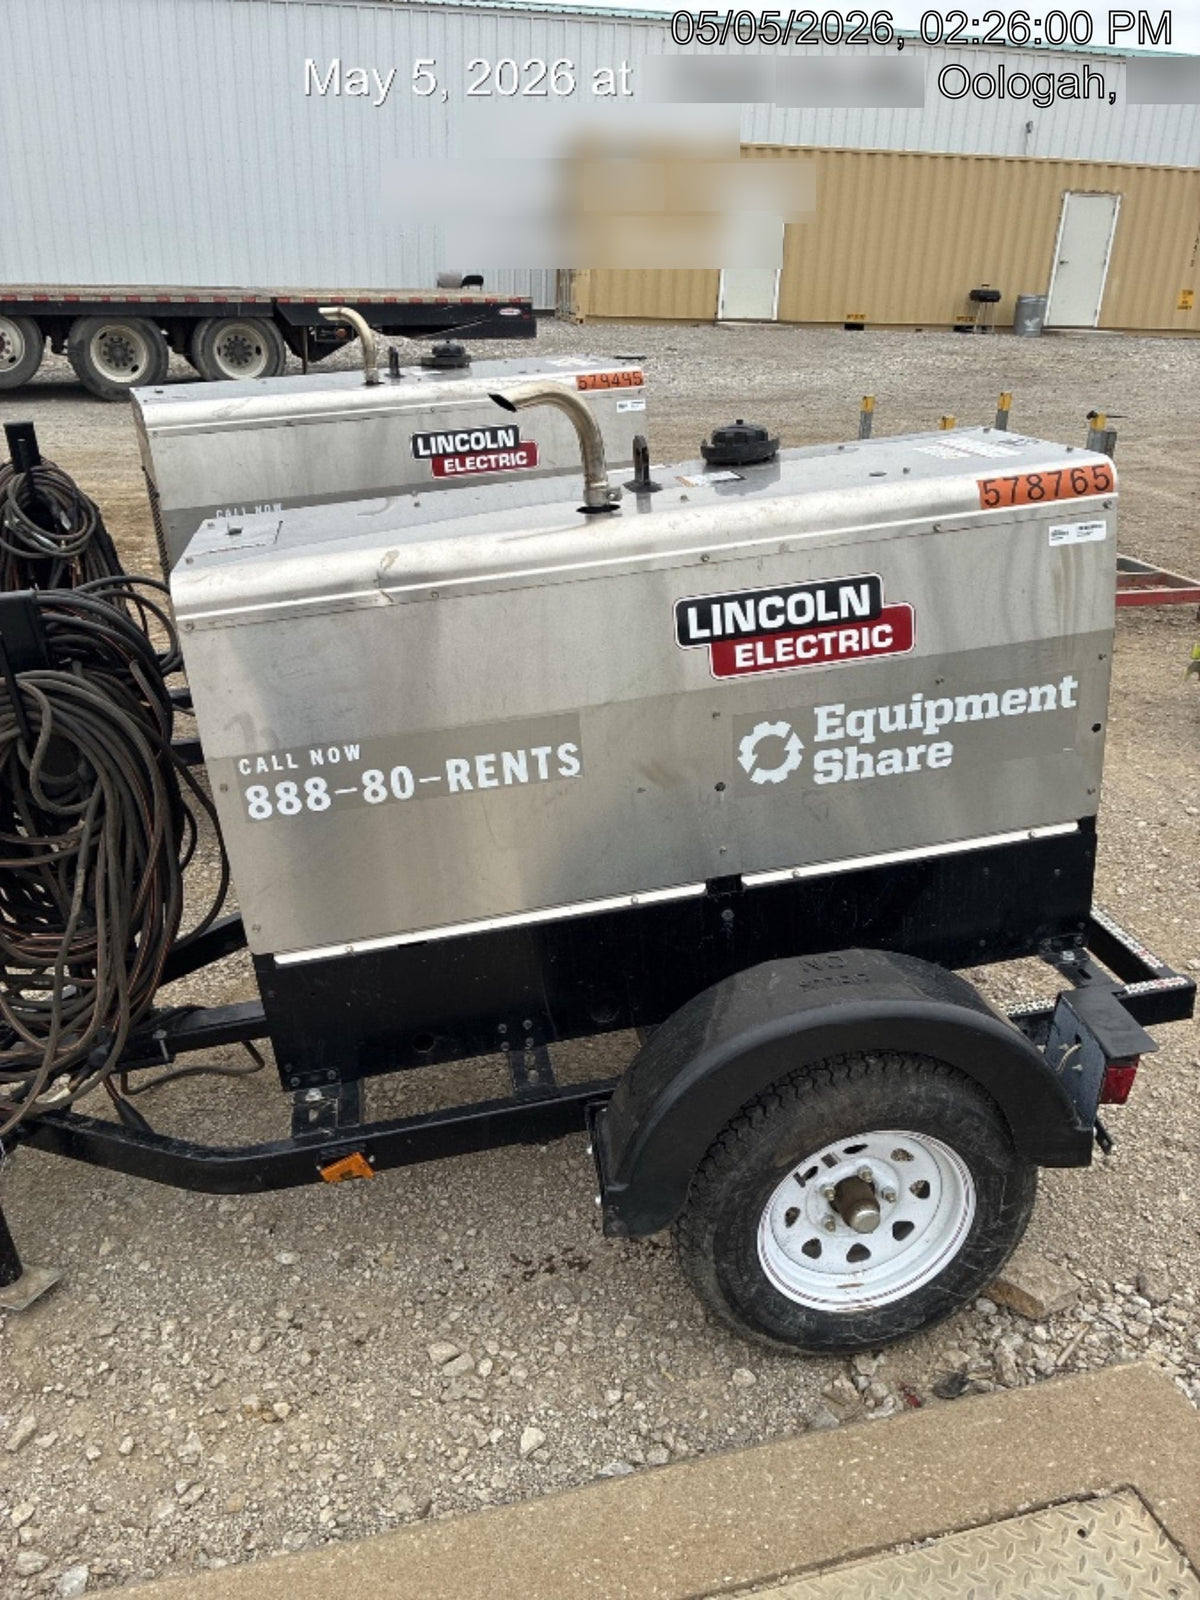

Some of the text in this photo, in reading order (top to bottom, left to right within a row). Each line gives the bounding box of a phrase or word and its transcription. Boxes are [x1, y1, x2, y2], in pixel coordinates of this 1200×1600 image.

[578, 371, 643, 390] 579495
[417, 428, 515, 457] LINCOLN
[443, 451, 527, 474] ELECTRIC
[983, 462, 1111, 507] 578765
[687, 583, 871, 640] LINCOLN
[734, 623, 894, 669] ELECTRIC
[813, 675, 1079, 744] Equipment
[238, 743, 362, 776] CALL NOW
[245, 742, 581, 820] 888-80-RENTS
[813, 740, 954, 785] Share
